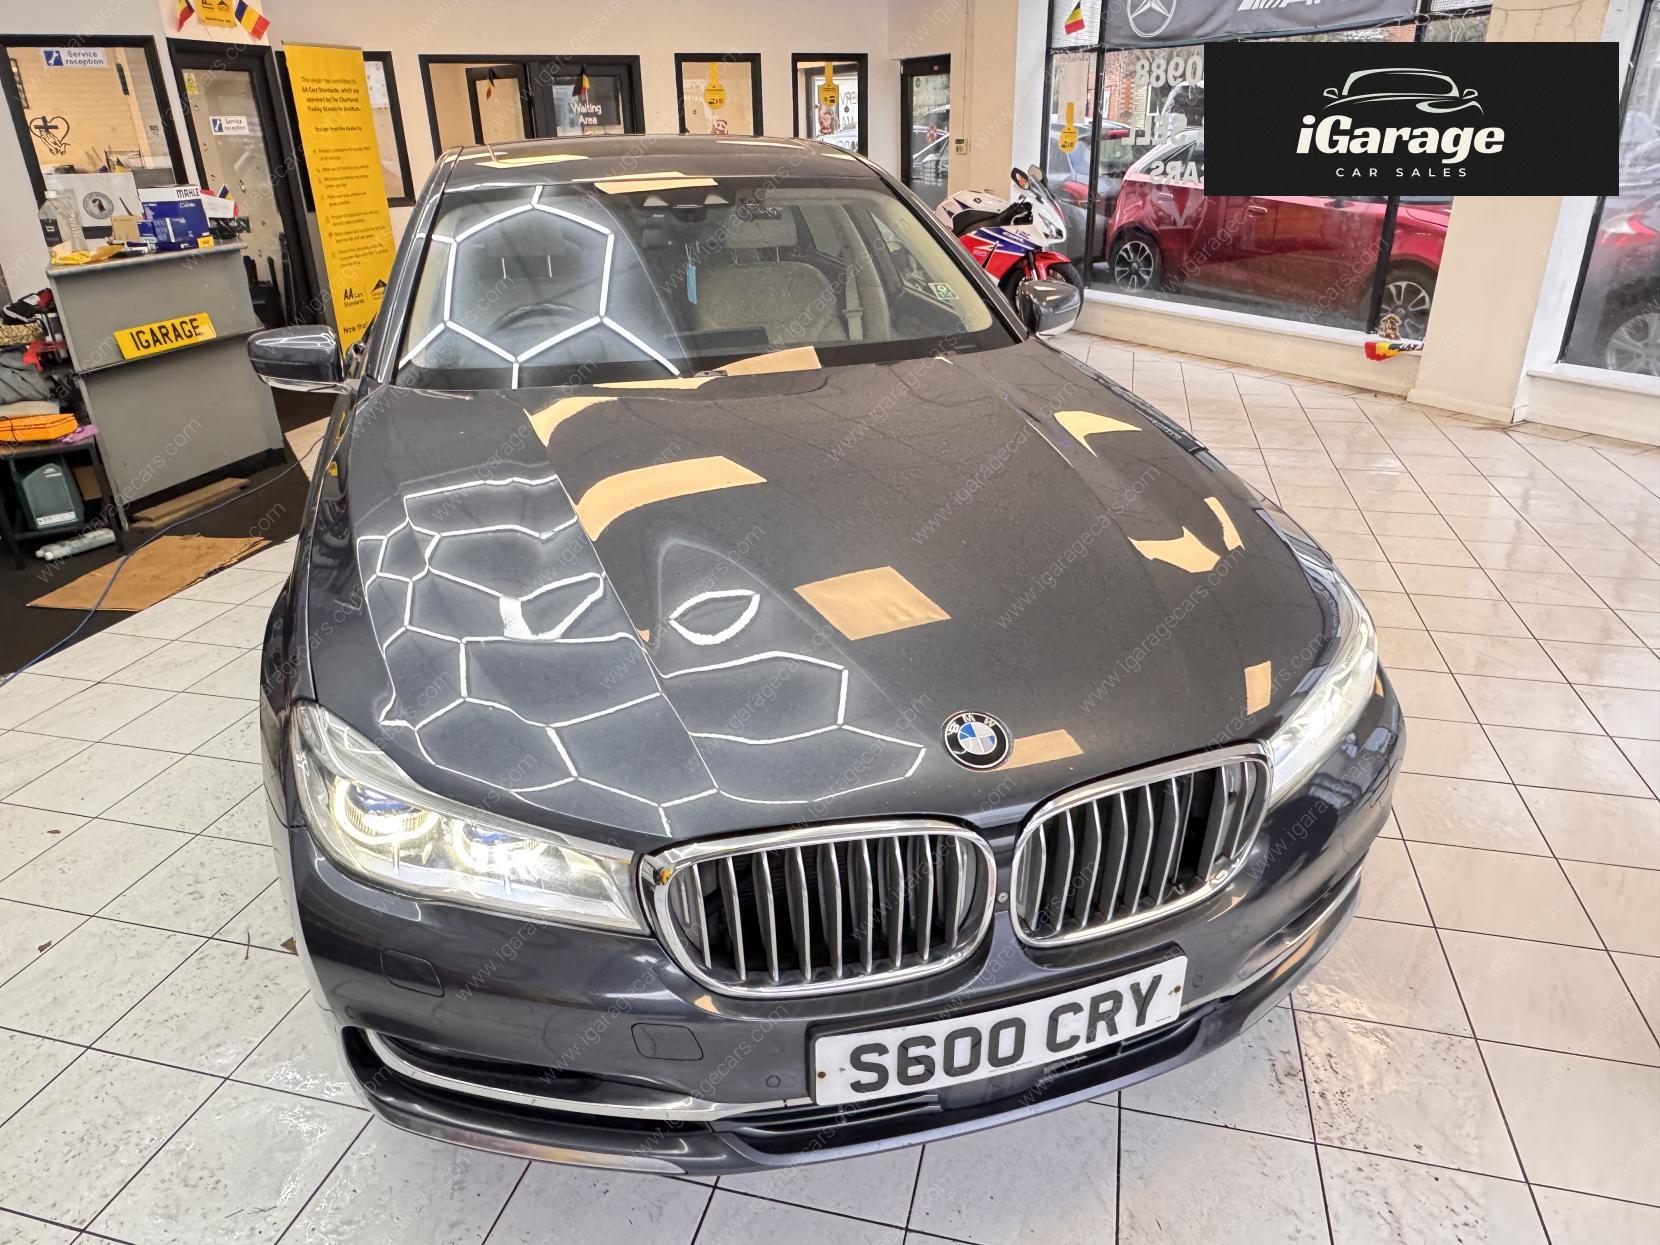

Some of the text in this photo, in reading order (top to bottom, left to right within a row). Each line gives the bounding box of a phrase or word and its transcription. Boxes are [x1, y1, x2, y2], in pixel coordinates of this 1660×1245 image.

[571, 103, 602, 115] Waiting
[579, 115, 598, 125] Area
[176, 187, 200, 199] MAHLE
[129, 317, 201, 352] IGARAGE
[849, 1016, 1027, 1094] S600
[1045, 973, 1163, 1054] CRY
